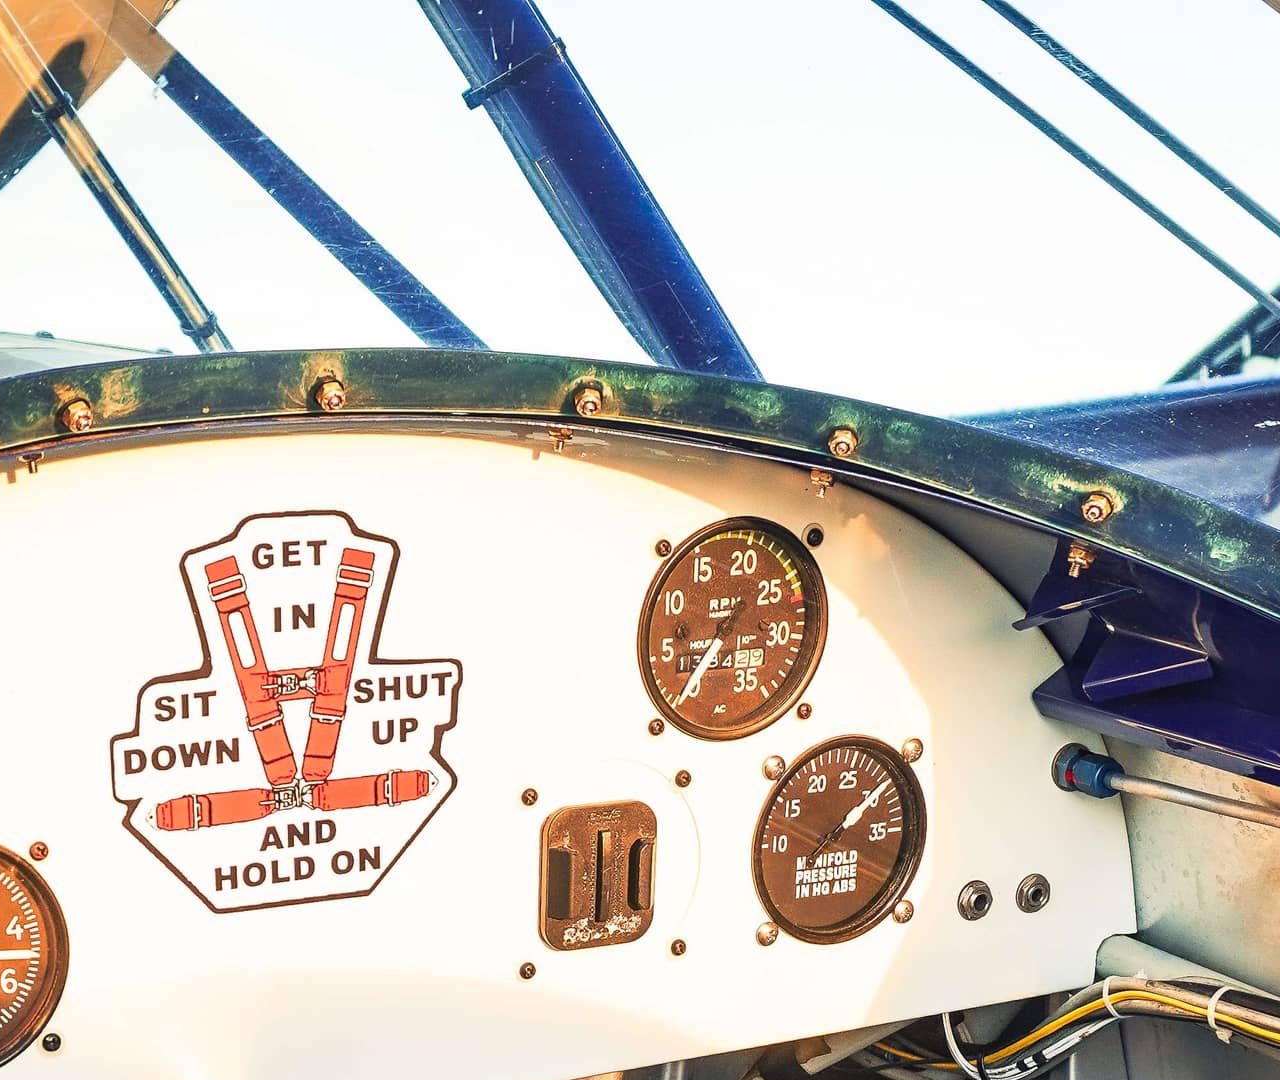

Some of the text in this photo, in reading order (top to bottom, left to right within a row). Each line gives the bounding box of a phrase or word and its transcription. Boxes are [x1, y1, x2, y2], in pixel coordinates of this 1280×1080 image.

[252, 540, 327, 569] GET
[730, 549, 758, 577] 20
[693, 556, 713, 583] 15
[665, 589, 684, 616] 10
[757, 579, 783, 606] 25
[273, 603, 315, 632] IN
[766, 620, 790, 647] 30
[661, 637, 674, 663] 5
[353, 672, 452, 704] SHUT
[733, 668, 758, 693] 35
[154, 690, 217, 722] SIT
[371, 717, 419, 746] UP
[123, 738, 240, 775] DOWN
[807, 775, 827, 793] 20
[838, 770, 858, 790] 25
[784, 799, 801, 818] 15
[260, 819, 336, 851] AND
[772, 835, 788, 853] 10
[868, 821, 887, 842] 35
[215, 846, 381, 891] HOLD ON
[796, 850, 857, 870] MNIFOLD
[796, 864, 857, 884] PRESSURE
[795, 878, 857, 900] IN HG ABS
[5, 915, 24, 940] 4
[0, 968, 18, 994] 6
